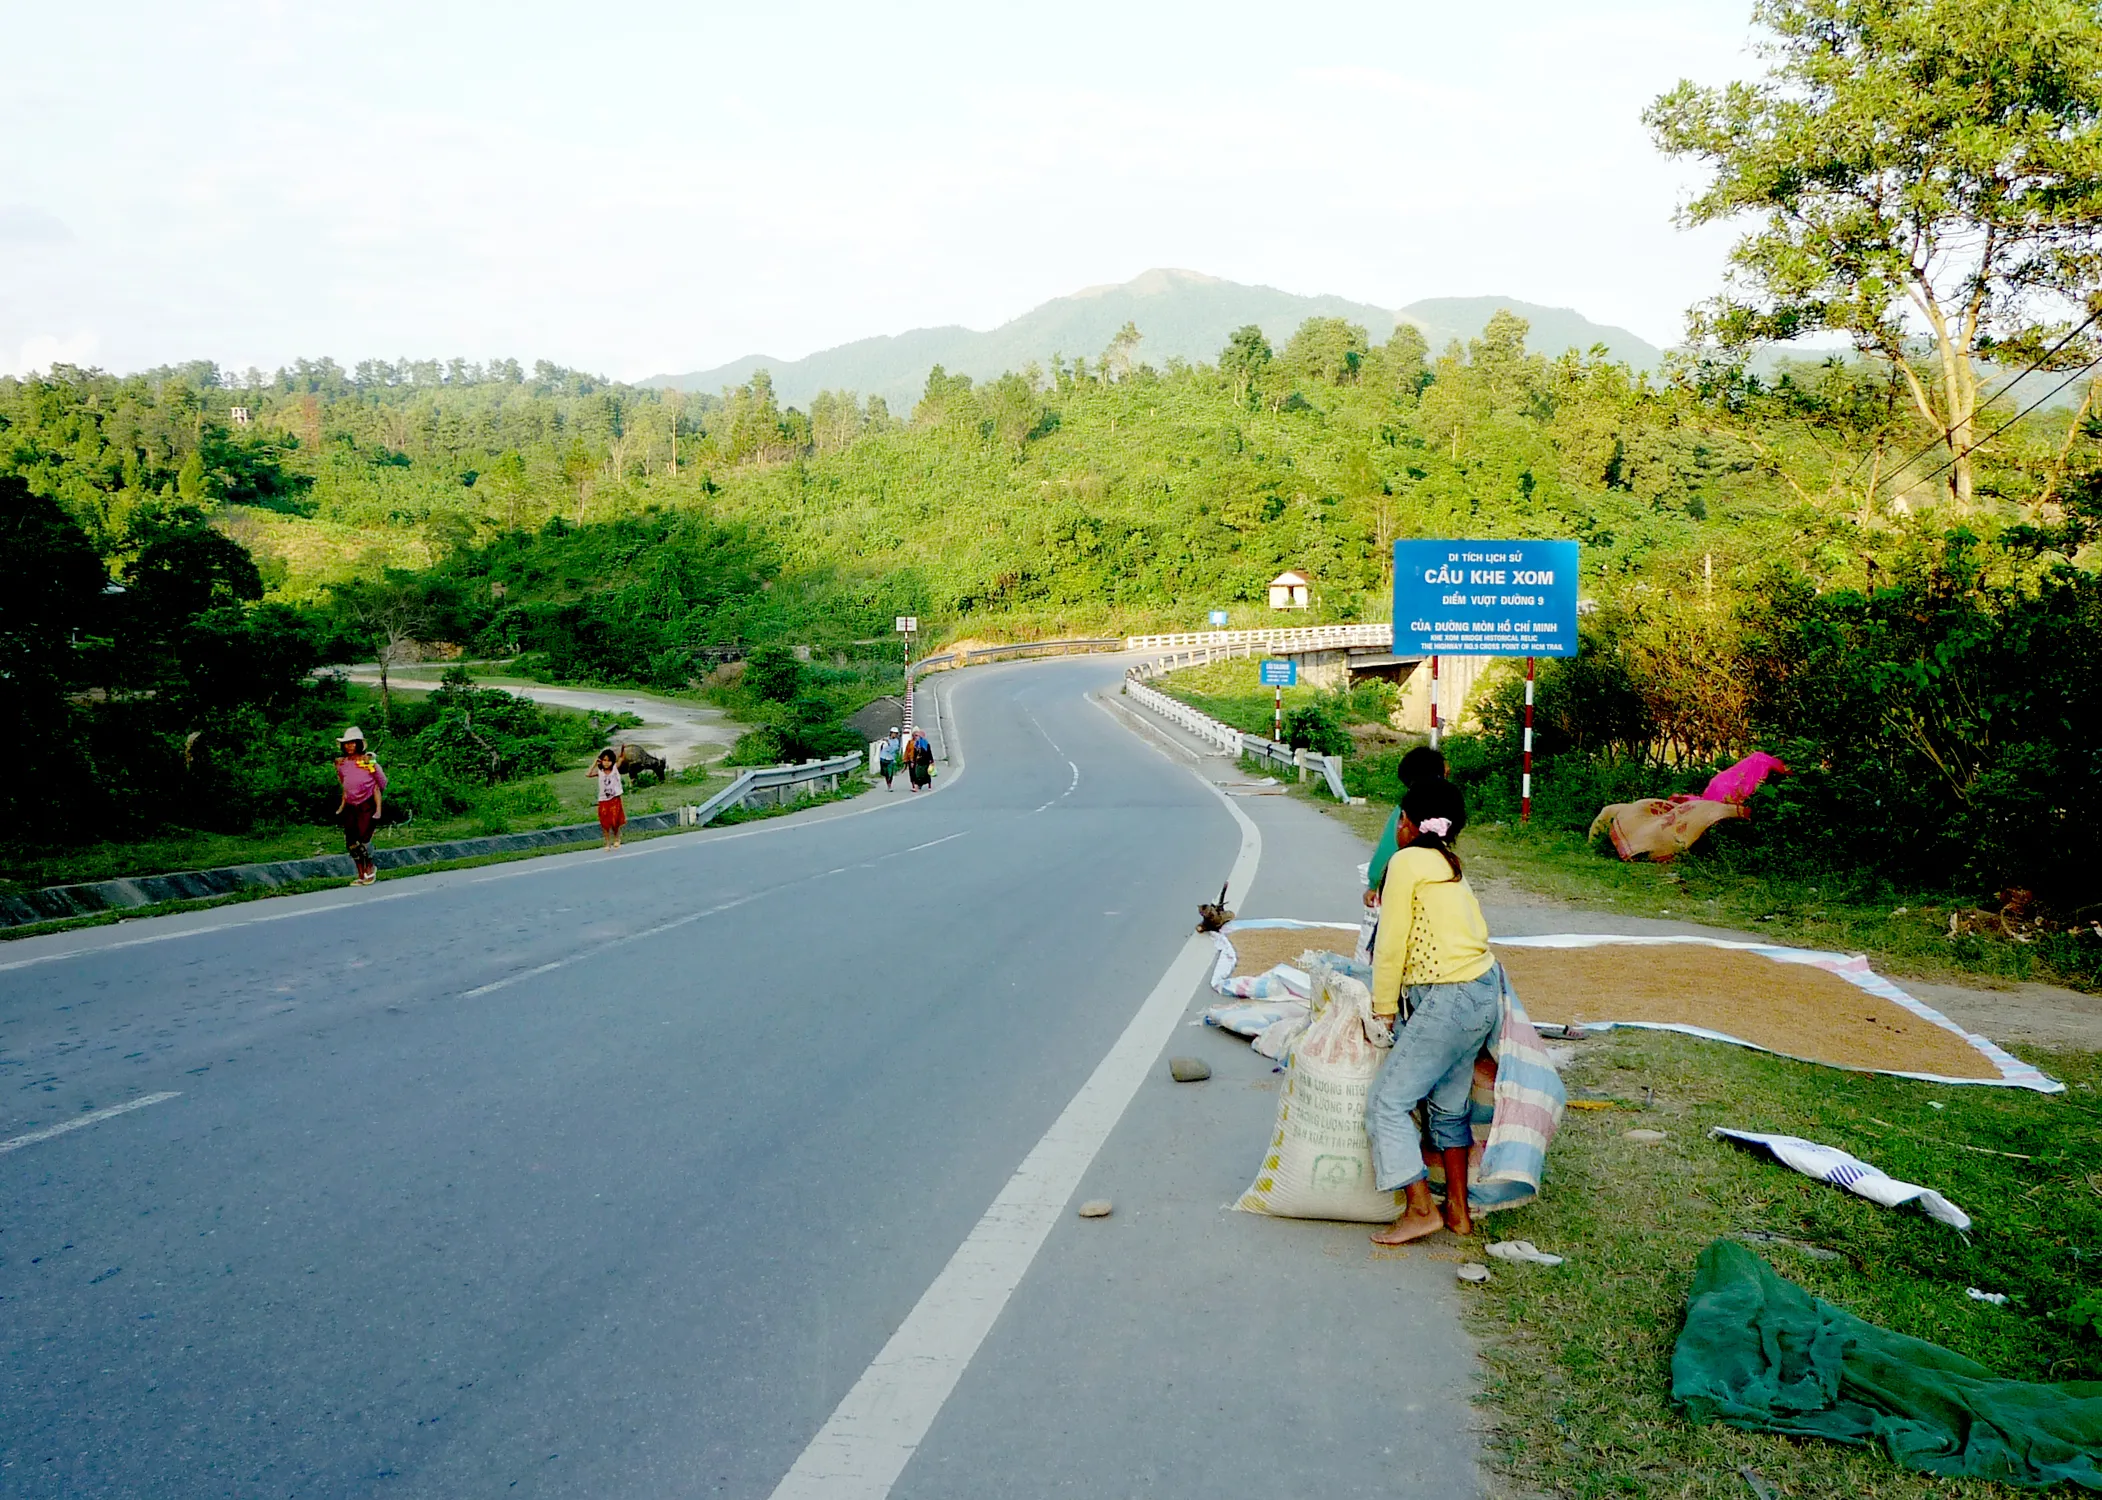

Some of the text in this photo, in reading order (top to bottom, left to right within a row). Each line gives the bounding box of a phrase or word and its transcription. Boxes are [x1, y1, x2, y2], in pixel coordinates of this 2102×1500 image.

[1448, 550, 1523, 564] DI TÍCH LỊCH SỬ
[1424, 564, 1554, 585] CẦU KHE XOM
[1470, 594, 1497, 607] VƯỢT
[1537, 596, 1544, 605] 9
[1410, 618, 1431, 631] CỦA
[1472, 620, 1495, 632] MÒN
[1513, 620, 1531, 632] CHÍ
[1532, 622, 1558, 632] MINH
[1483, 634, 1519, 642] HISTORICAL
[1520, 634, 1538, 642] RELIC
[1421, 642, 1433, 650] THE
[1433, 642, 1463, 650] HIGHWAY
